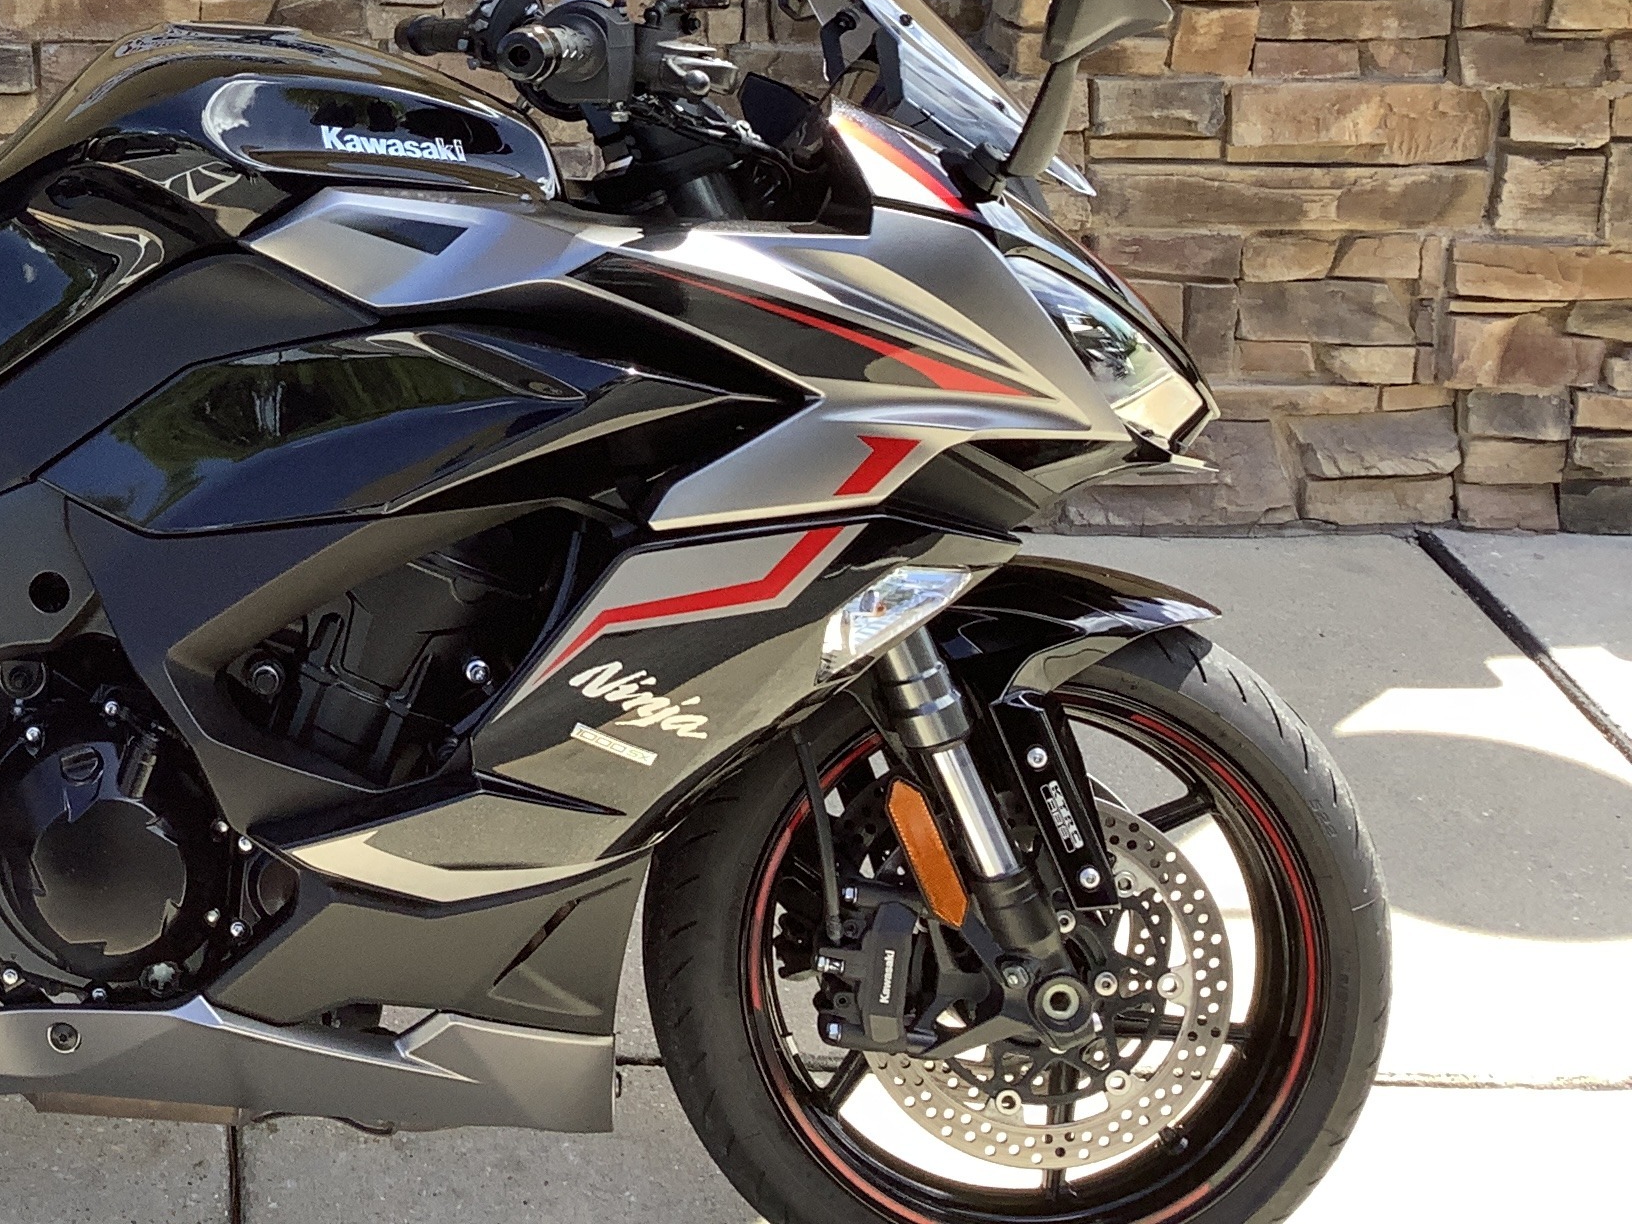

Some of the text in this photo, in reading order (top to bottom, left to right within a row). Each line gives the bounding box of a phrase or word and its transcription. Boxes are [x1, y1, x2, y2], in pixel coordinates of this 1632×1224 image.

[320, 124, 468, 163] Kawasaki
[568, 660, 709, 740] Ninja
[879, 949, 896, 1004] Kawasaki
